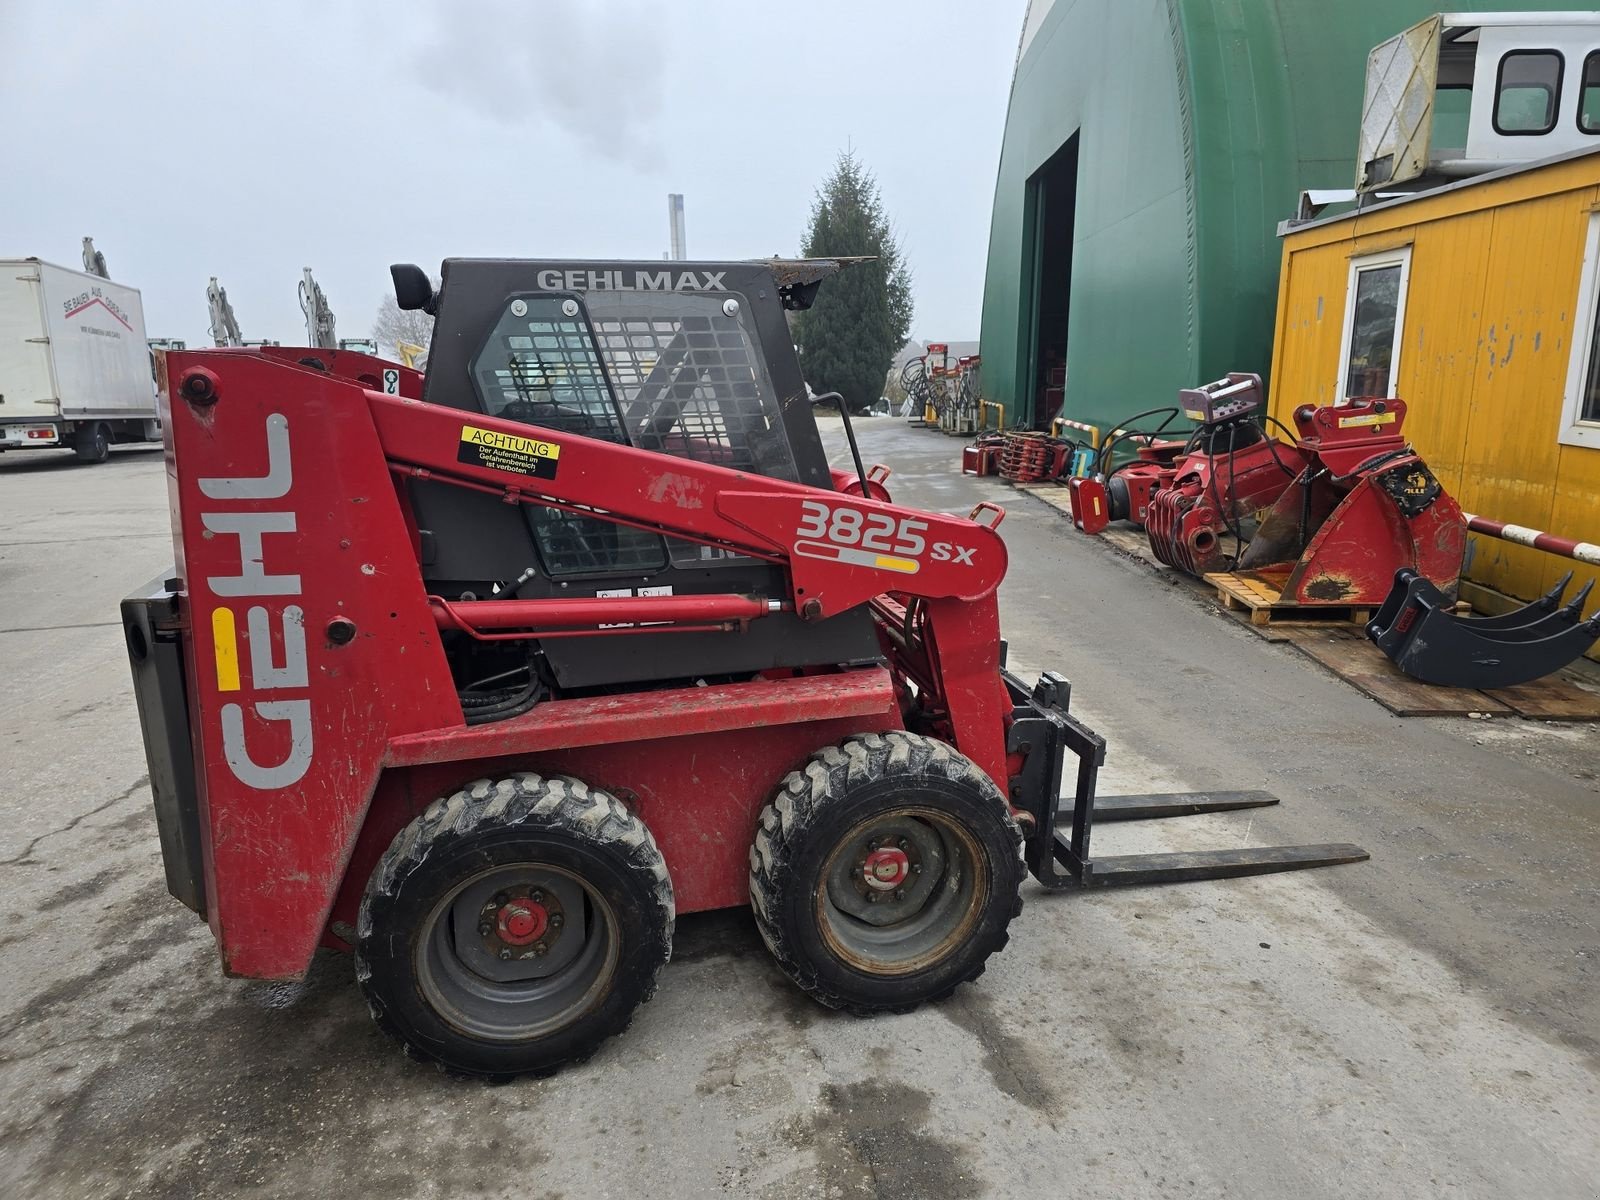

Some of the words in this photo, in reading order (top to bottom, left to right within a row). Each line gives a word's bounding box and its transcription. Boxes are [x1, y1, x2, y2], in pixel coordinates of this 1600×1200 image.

[537, 270, 727, 291] GEHLMAX
[471, 430, 549, 456] ACHTUNG
[478, 446, 492, 454] Der
[493, 448, 529, 462] Aufenthalt
[479, 452, 536, 470] Gefahrenbereich
[496, 463, 527, 475] verboten
[796, 500, 929, 556] 3825
[197, 413, 314, 790] GEHL
